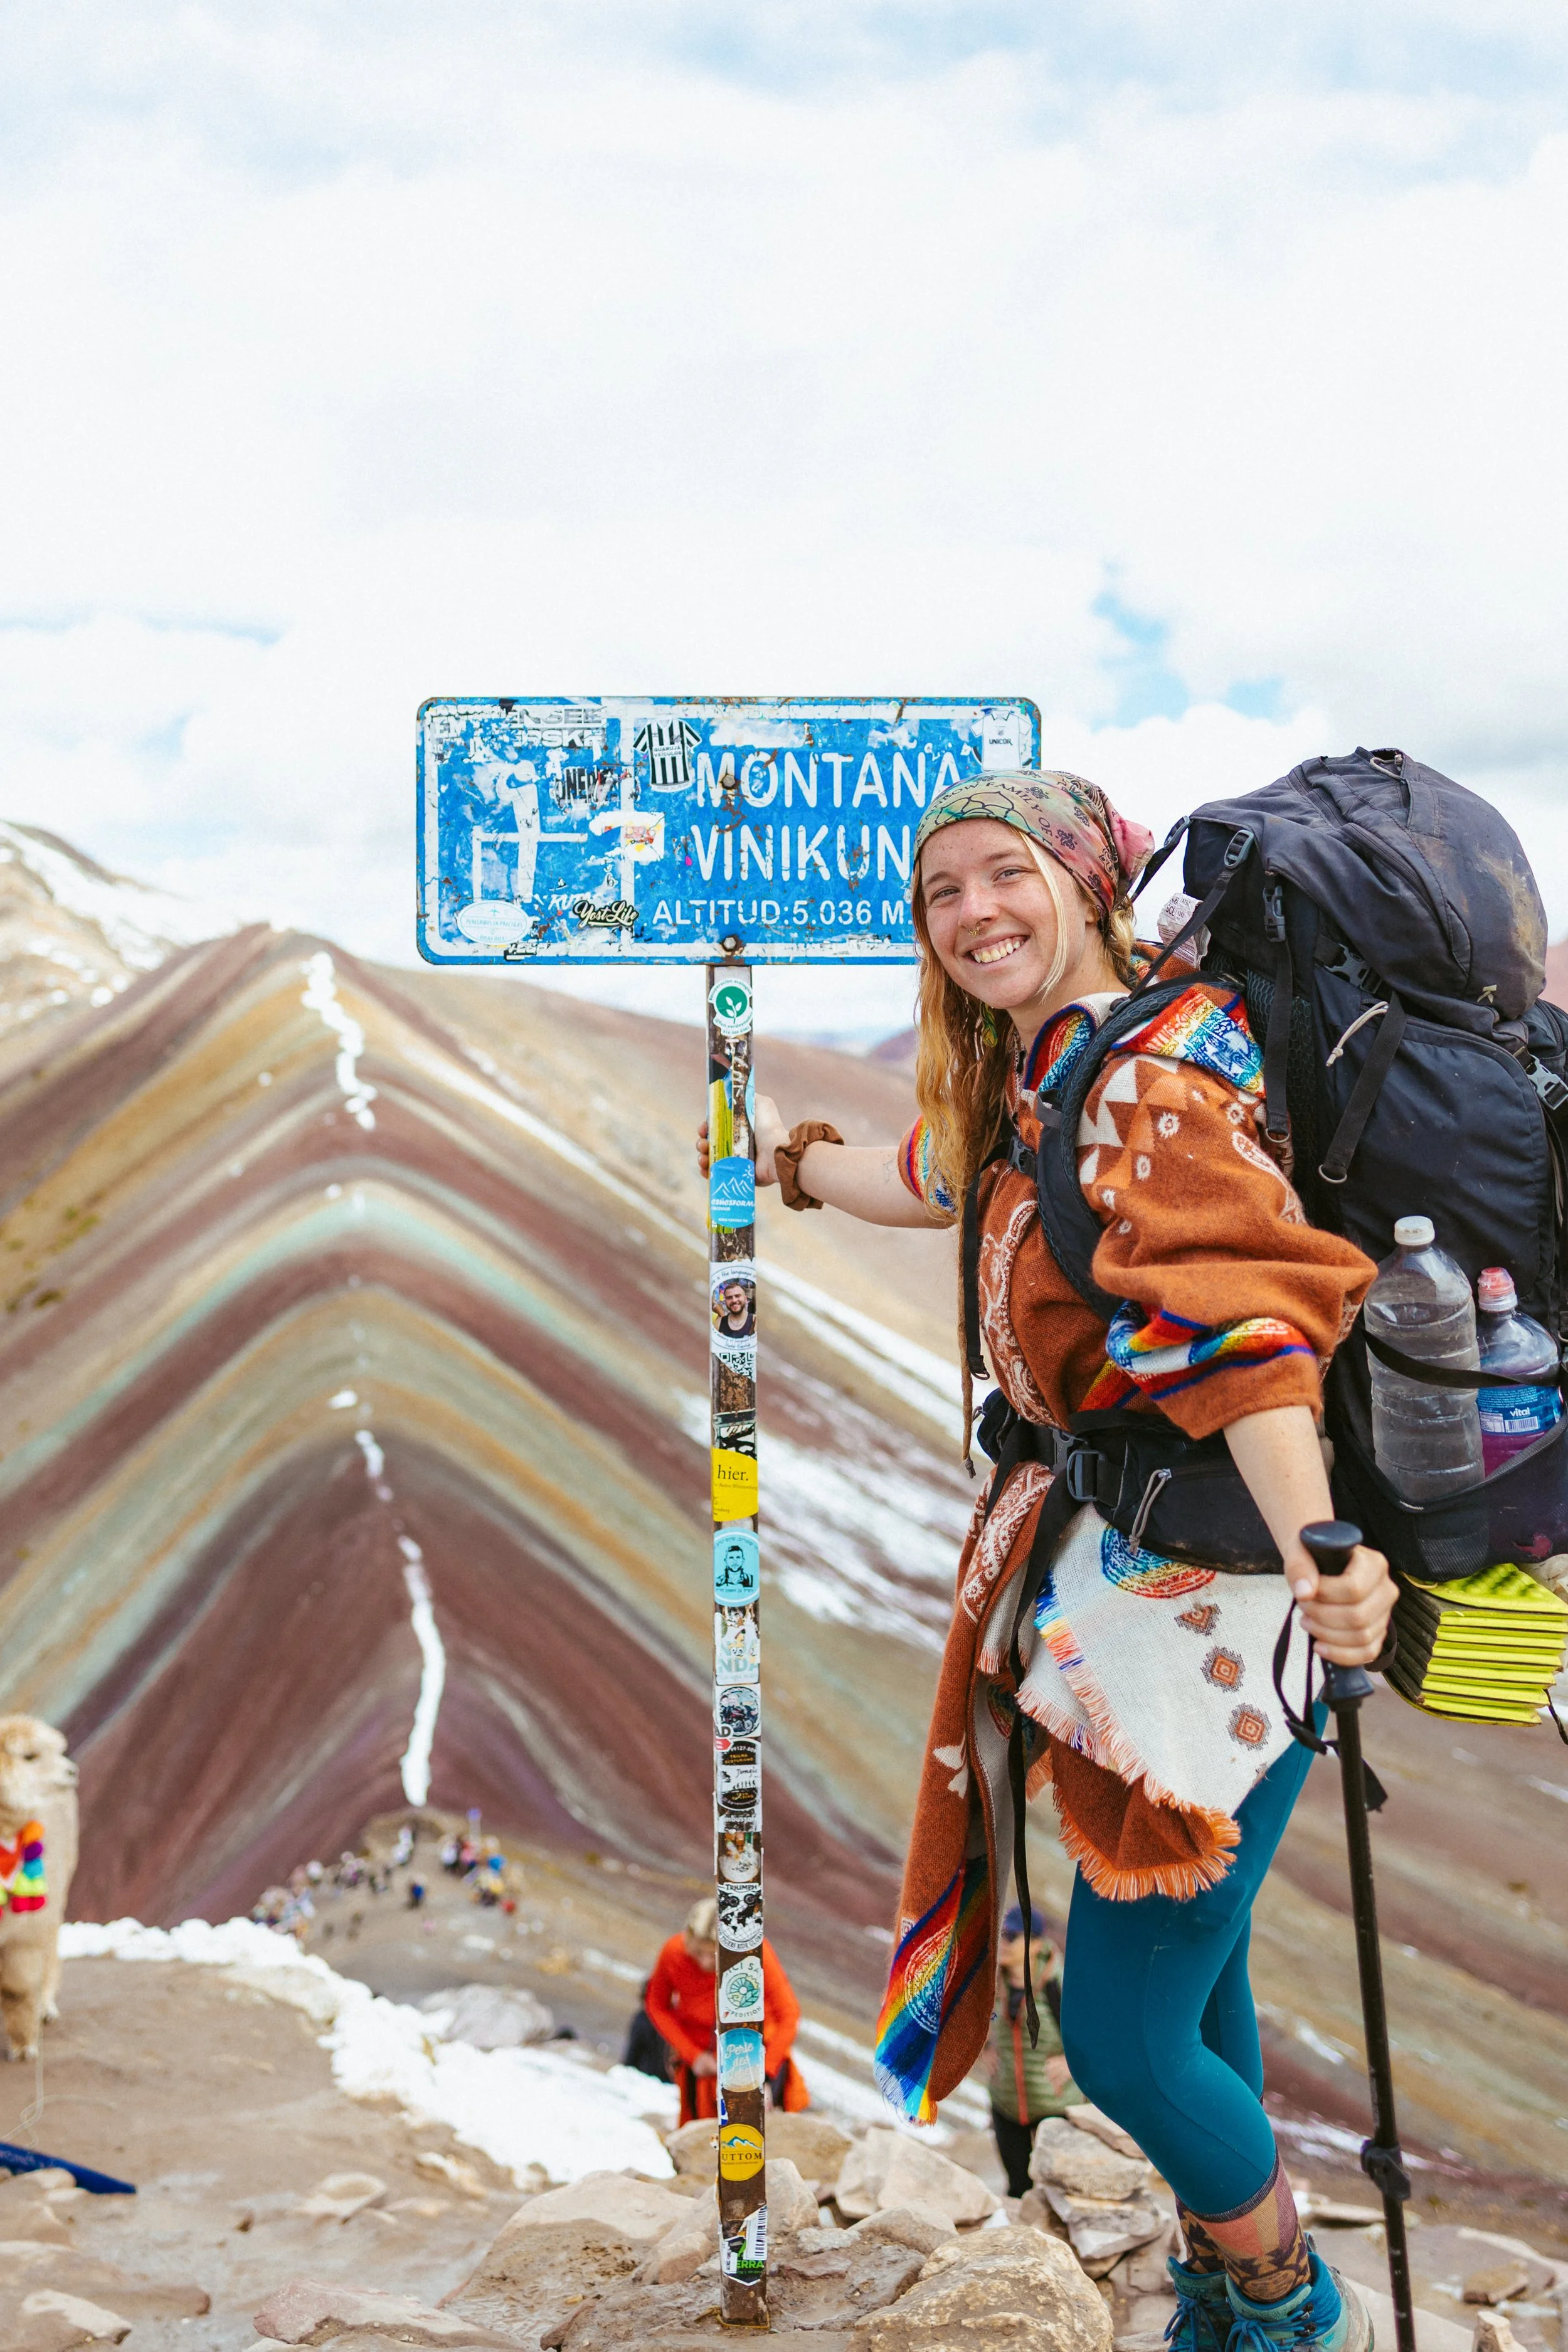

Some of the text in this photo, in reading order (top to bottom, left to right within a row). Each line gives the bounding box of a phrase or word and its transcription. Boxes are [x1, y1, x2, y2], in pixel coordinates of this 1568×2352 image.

[697, 752, 961, 808] MONTANA
[986, 782, 1043, 813] FAMILY
[1038, 817, 1053, 837] OF
[605, 901, 637, 926] Life
[1165, 905, 1175, 916] SCL
[731, 1269, 751, 1278] language
[1510, 1407, 1530, 1417] vital
[718, 1465, 748, 1481] hier.
[724, 2006, 761, 2018] PEDITION
[737, 2260, 763, 2269] ERRA
